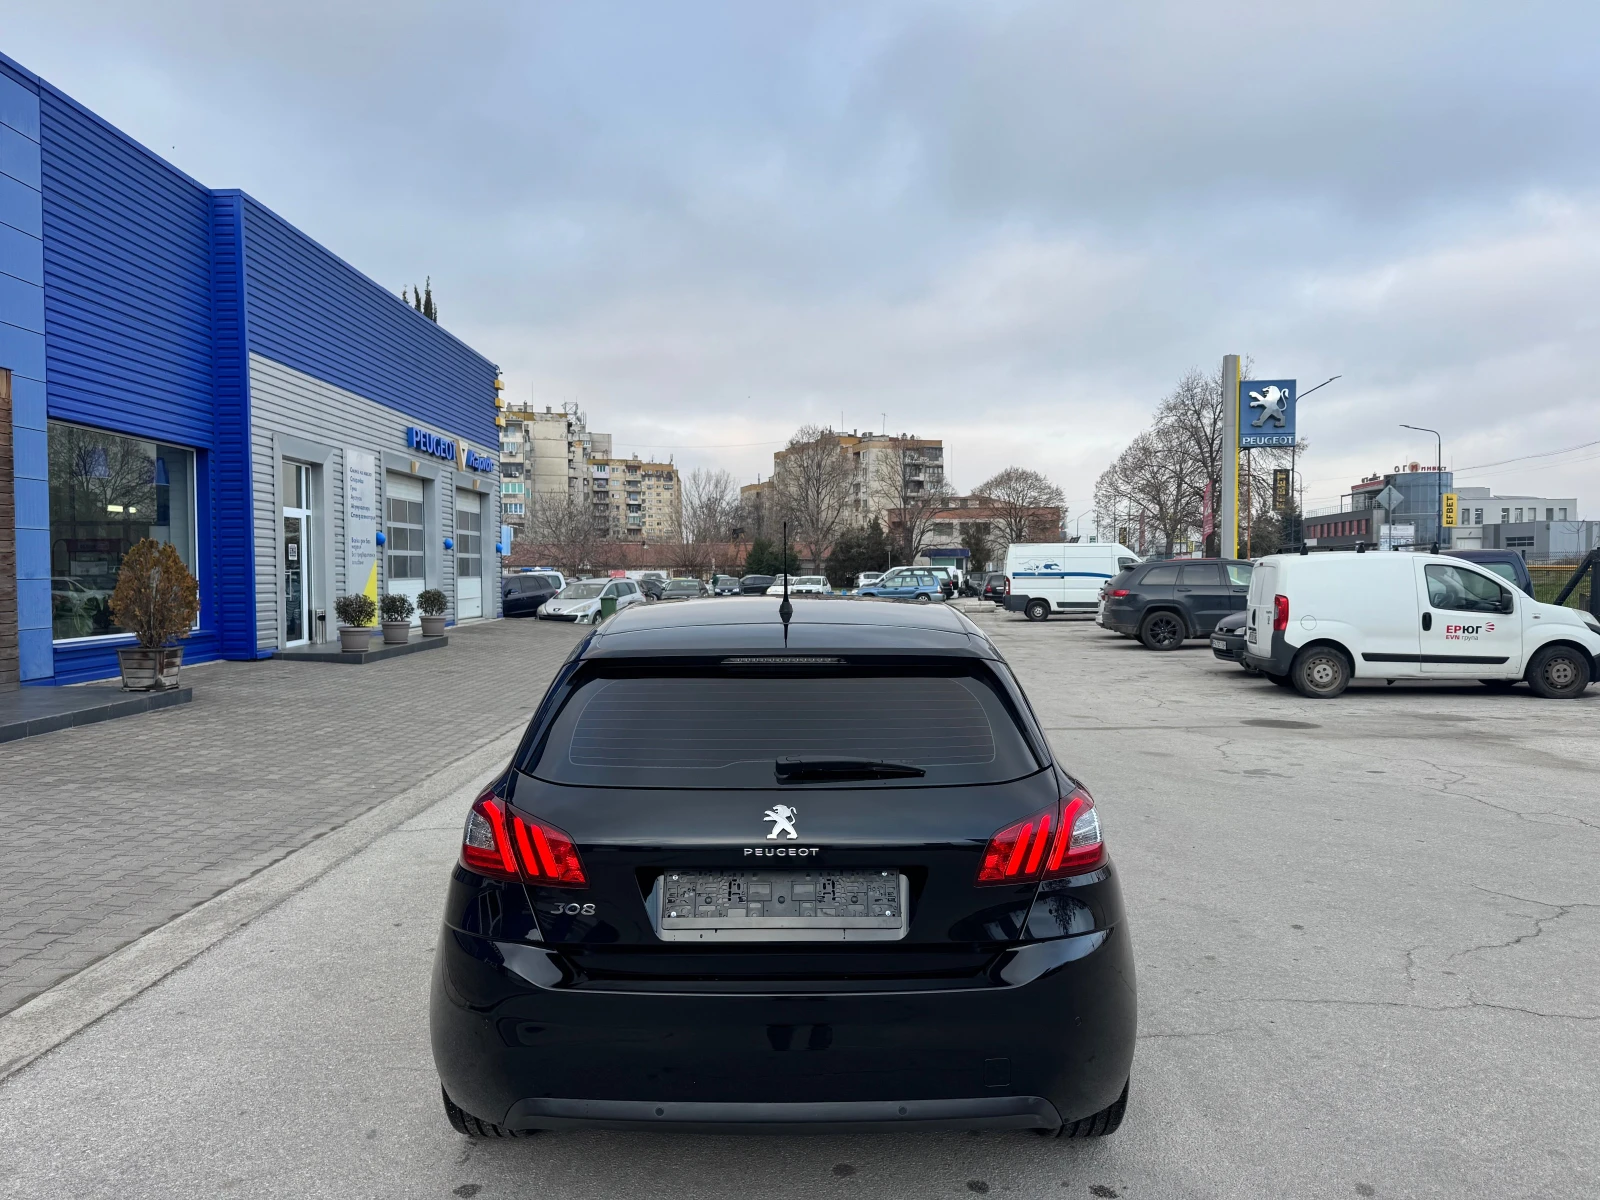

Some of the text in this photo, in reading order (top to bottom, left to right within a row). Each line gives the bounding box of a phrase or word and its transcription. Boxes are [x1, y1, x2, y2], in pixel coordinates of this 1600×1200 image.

[411, 427, 457, 461] PEUGEOT
[1242, 436, 1294, 445] PEUGEOT
[1446, 495, 1454, 525] EFBET
[1446, 625, 1482, 634] ЕРЮГ
[743, 848, 820, 857] PEUGEOT
[550, 902, 596, 916] 308
